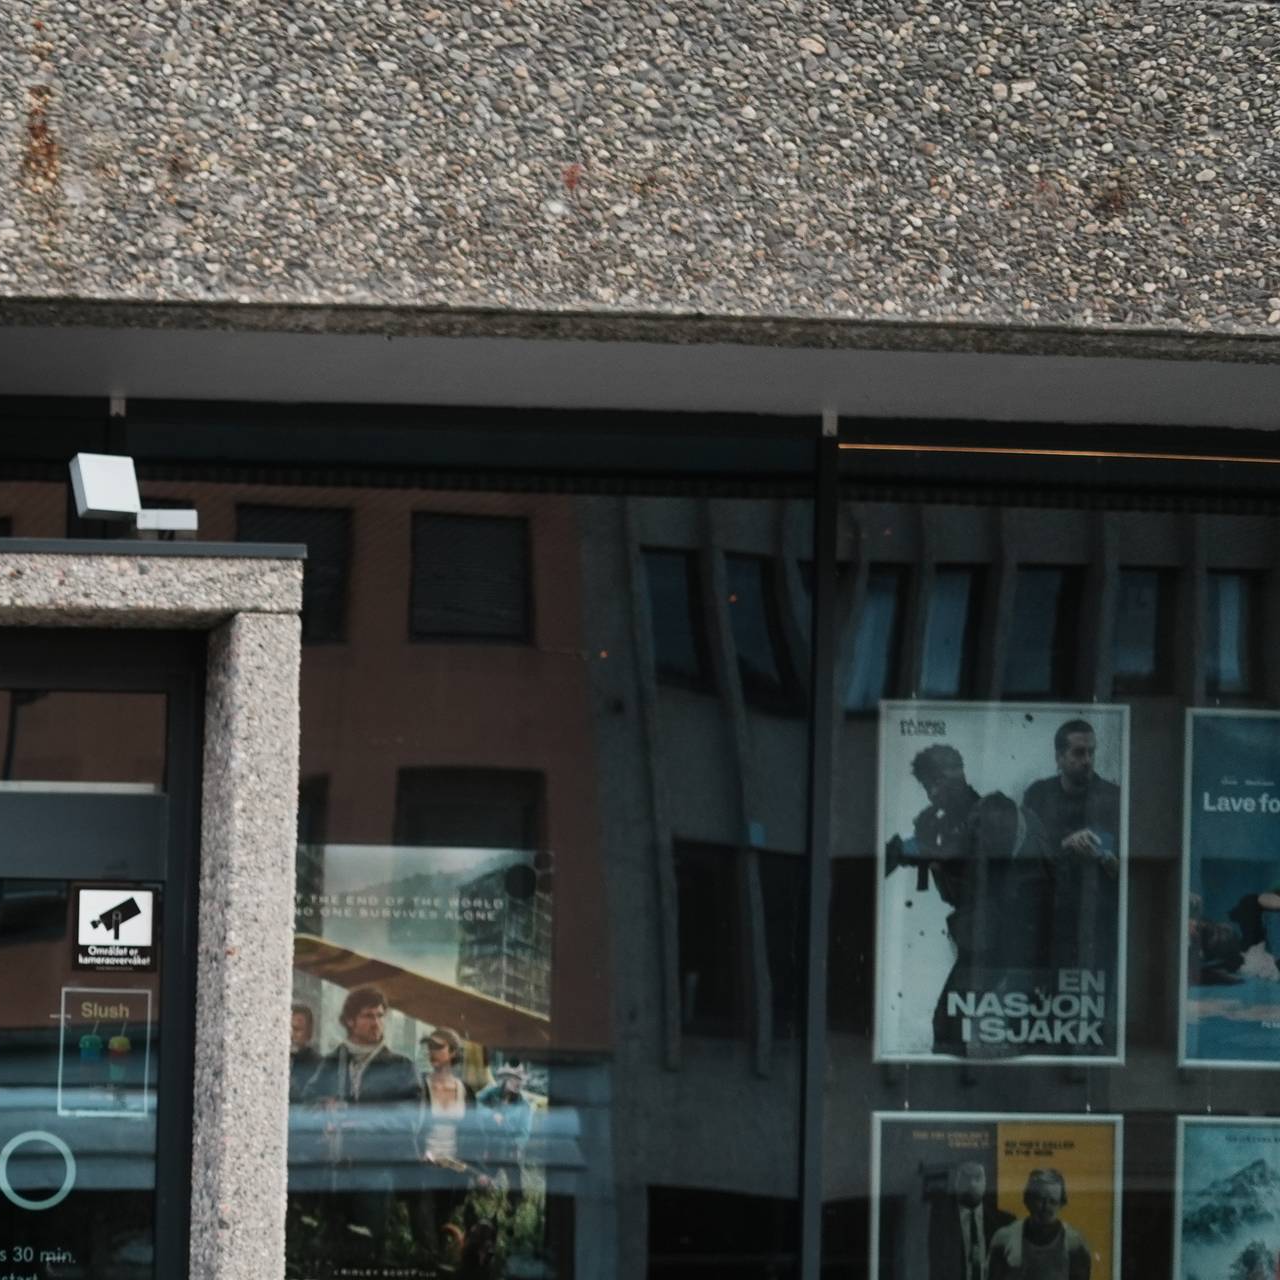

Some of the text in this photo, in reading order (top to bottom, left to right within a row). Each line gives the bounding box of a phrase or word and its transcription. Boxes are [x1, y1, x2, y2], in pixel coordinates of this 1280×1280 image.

[1058, 969, 1105, 992] EN
[81, 1002, 130, 1018] Slush
[947, 990, 1105, 1019] NASJON
[962, 1017, 1104, 1045] I SJAKK
[11, 1246, 34, 1261] 30
[40, 1247, 77, 1264] min.
